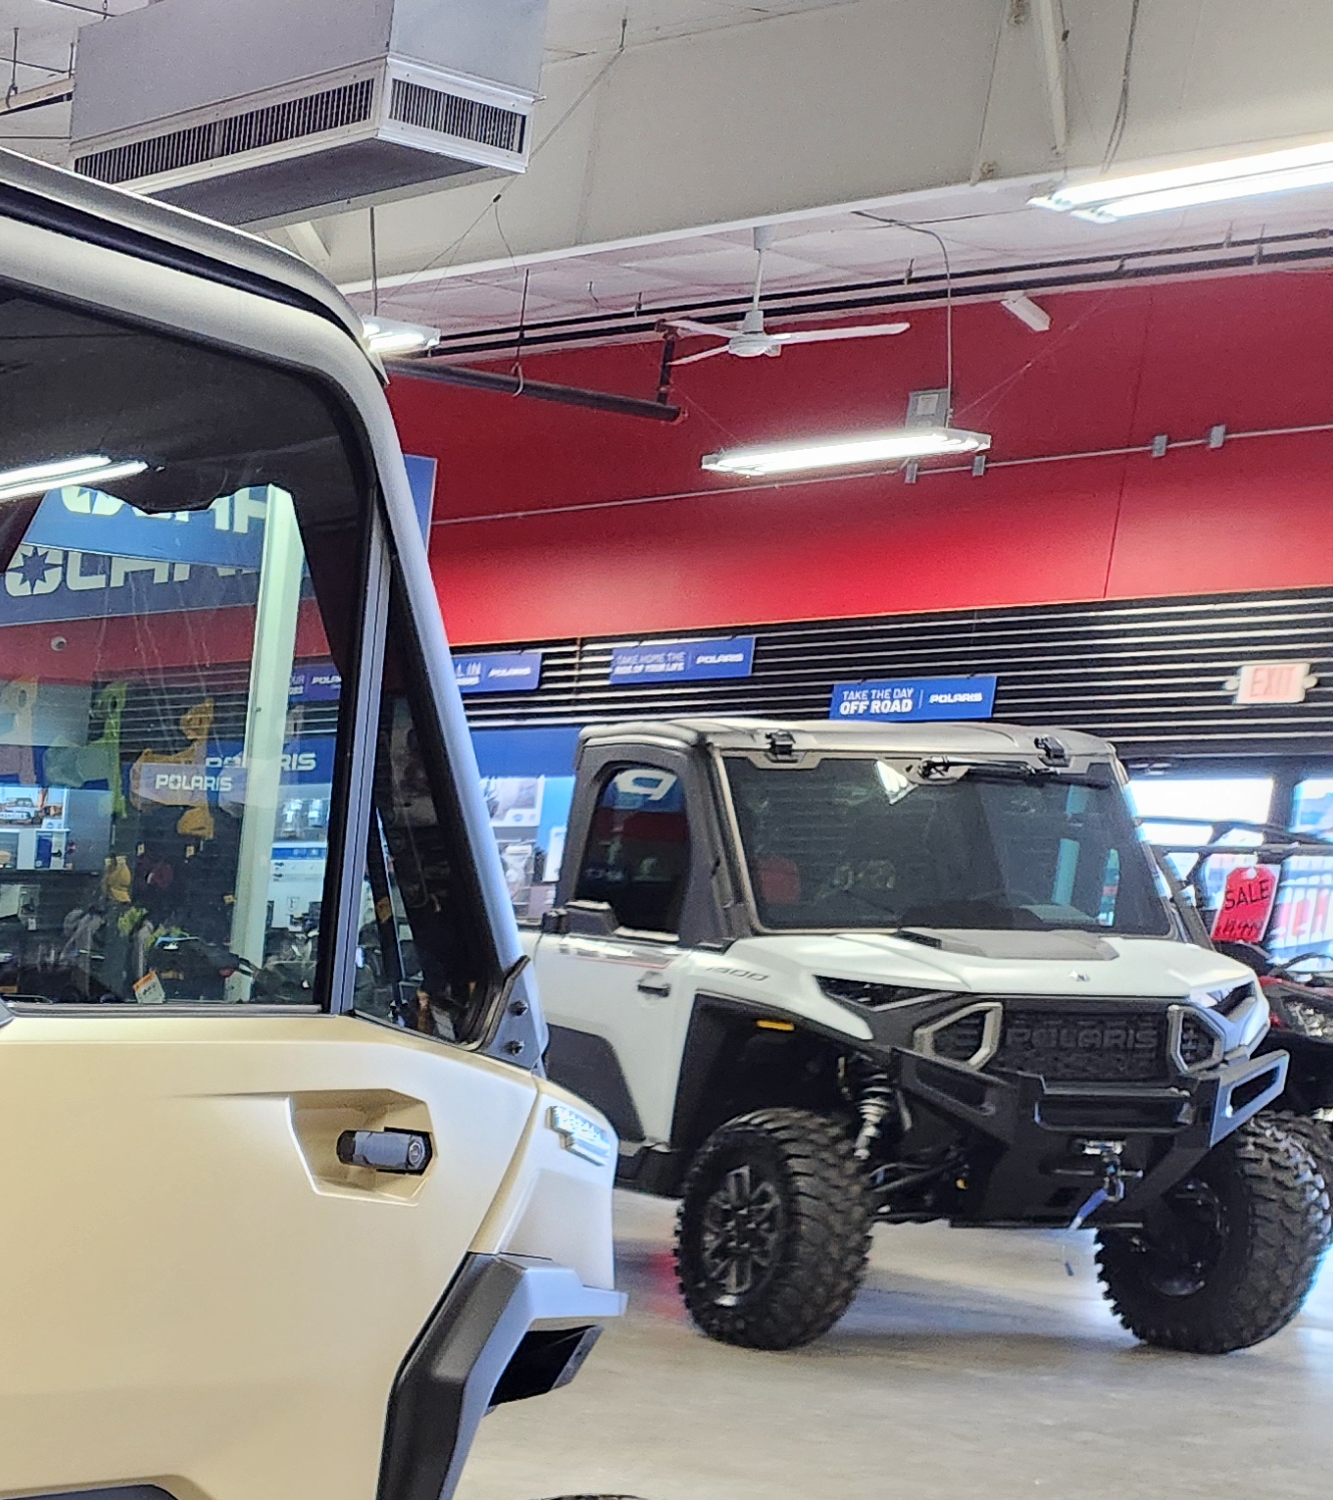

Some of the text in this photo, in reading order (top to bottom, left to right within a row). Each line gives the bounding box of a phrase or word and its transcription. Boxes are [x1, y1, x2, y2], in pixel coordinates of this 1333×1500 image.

[696, 653, 744, 664] POLARIS
[1249, 667, 1296, 698] EXIT
[842, 687, 914, 701] TAKE THE DAY
[929, 692, 983, 704] POLARIS
[839, 699, 913, 715] OFF ROAD
[155, 773, 233, 792] POLARIS
[1224, 879, 1270, 911] SALE
[1006, 1028, 1158, 1049] POLARIS
